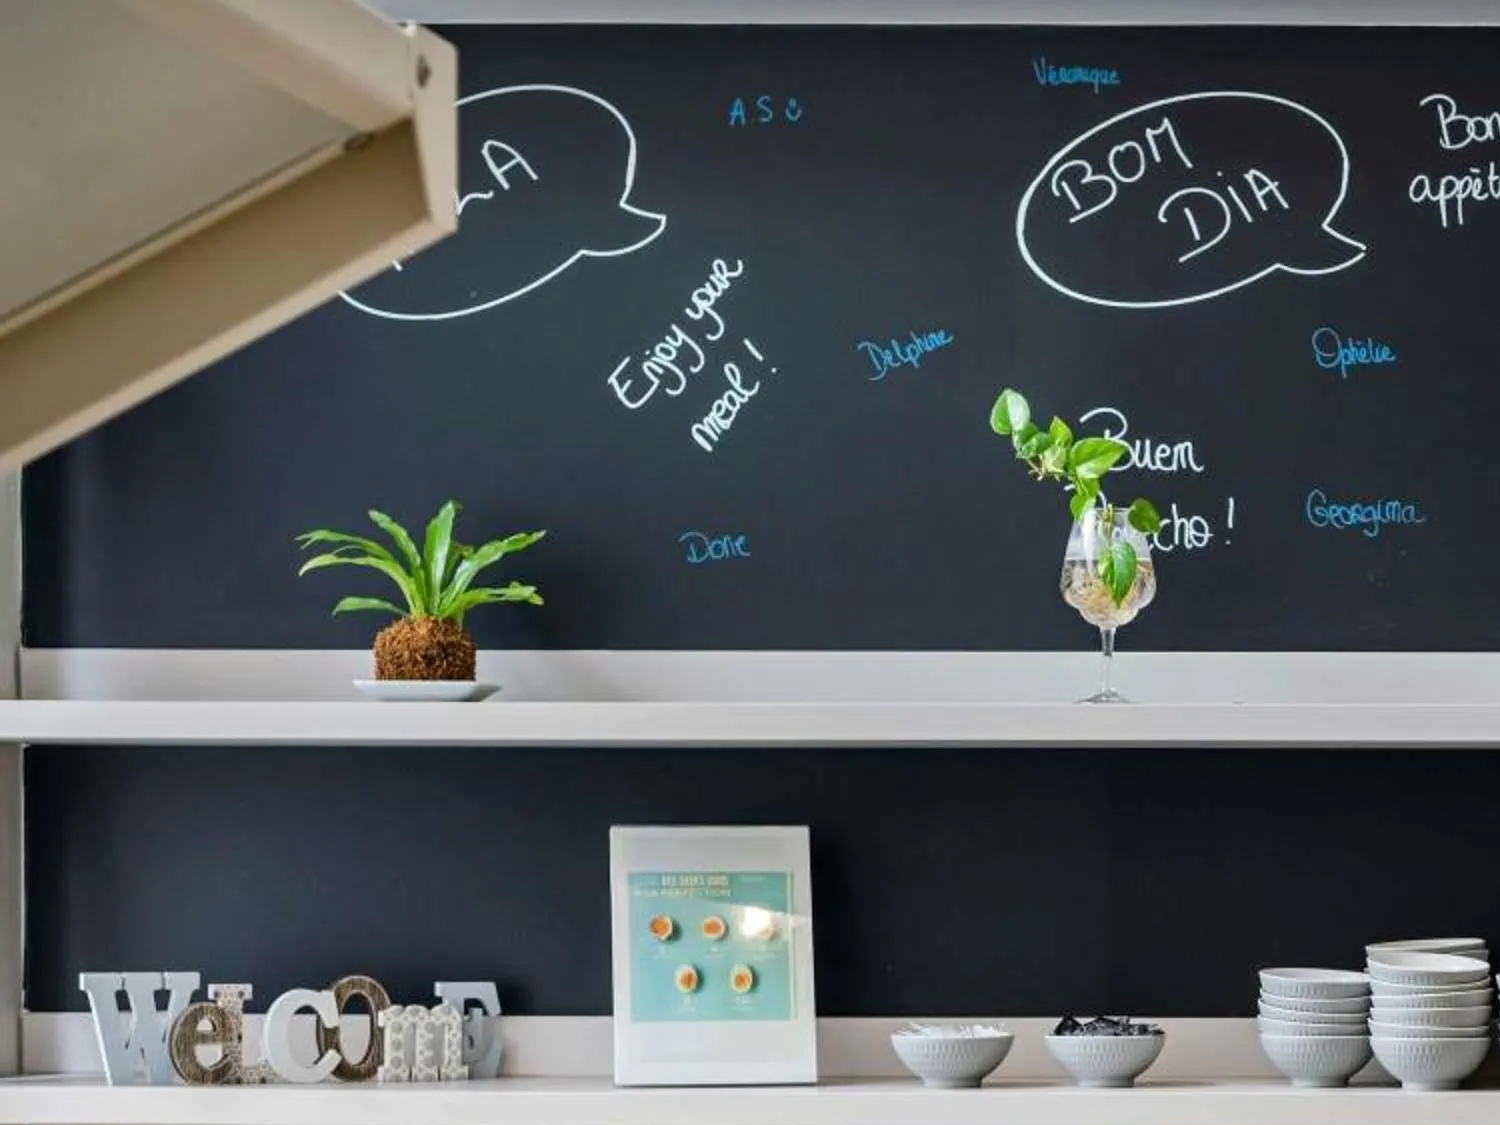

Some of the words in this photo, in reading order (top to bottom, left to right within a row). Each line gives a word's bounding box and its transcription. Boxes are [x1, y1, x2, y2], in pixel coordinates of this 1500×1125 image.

[1051, 116, 1193, 223] BOM
[607, 323, 705, 409] Enjoy
[684, 258, 744, 341] your
